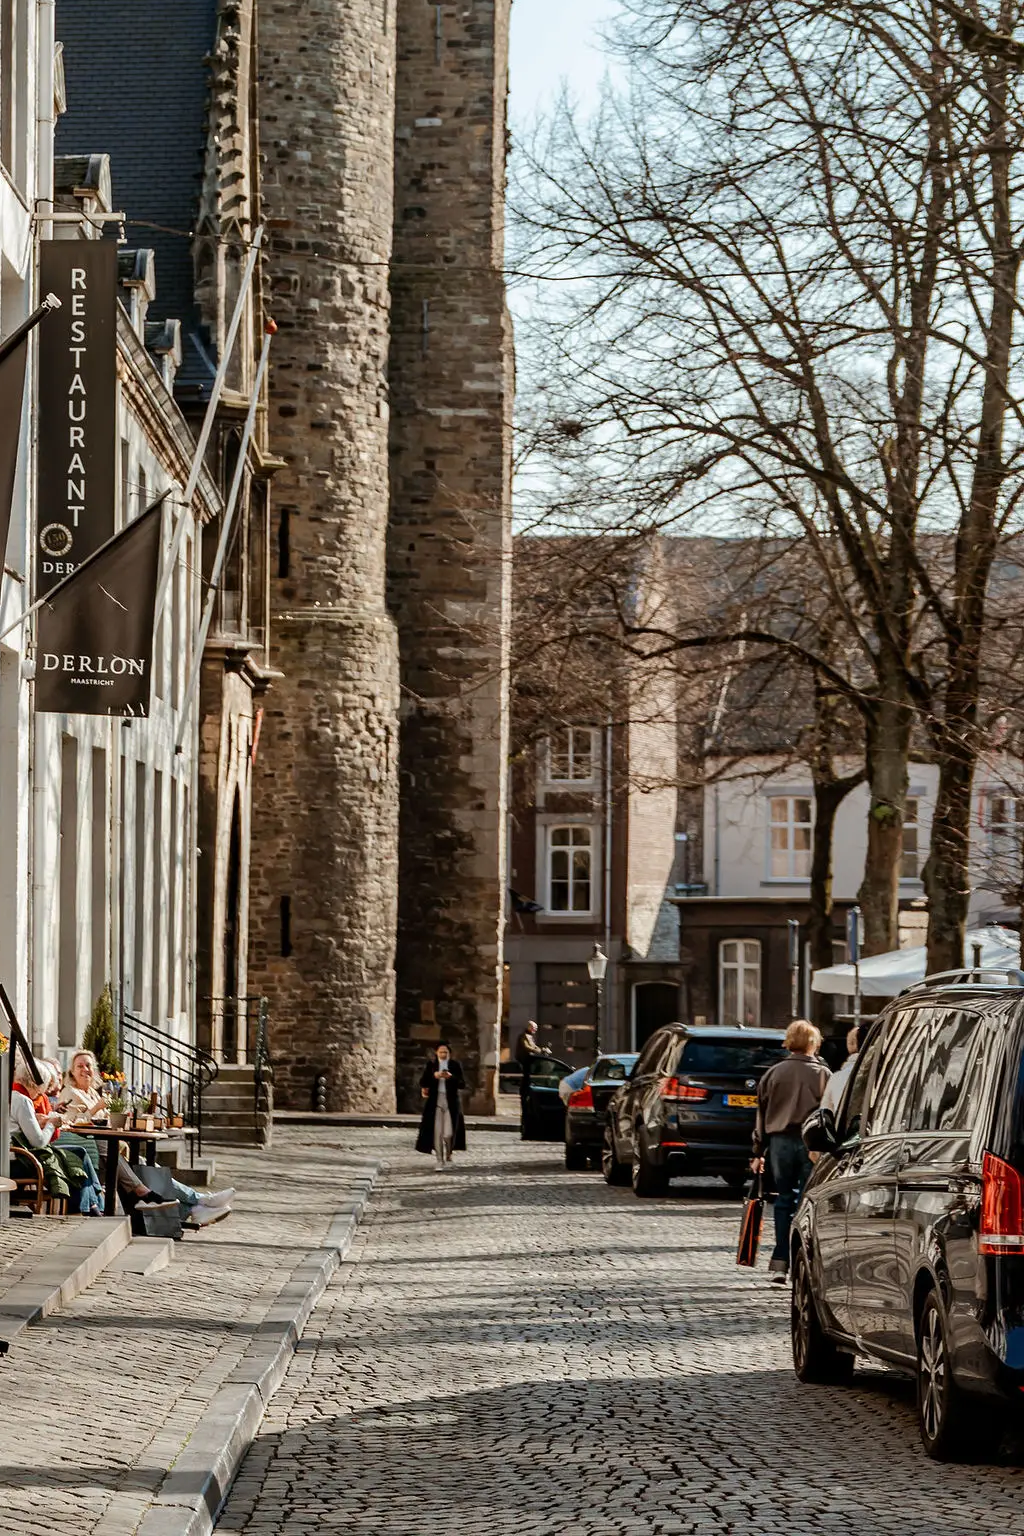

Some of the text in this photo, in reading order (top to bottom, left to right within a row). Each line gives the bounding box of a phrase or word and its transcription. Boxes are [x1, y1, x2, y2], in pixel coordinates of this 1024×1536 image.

[67, 268, 87, 527] RESTAURANT
[42, 562, 82, 574] DER
[43, 653, 146, 675] DERLON
[70, 678, 115, 686] MAASTRICHT
